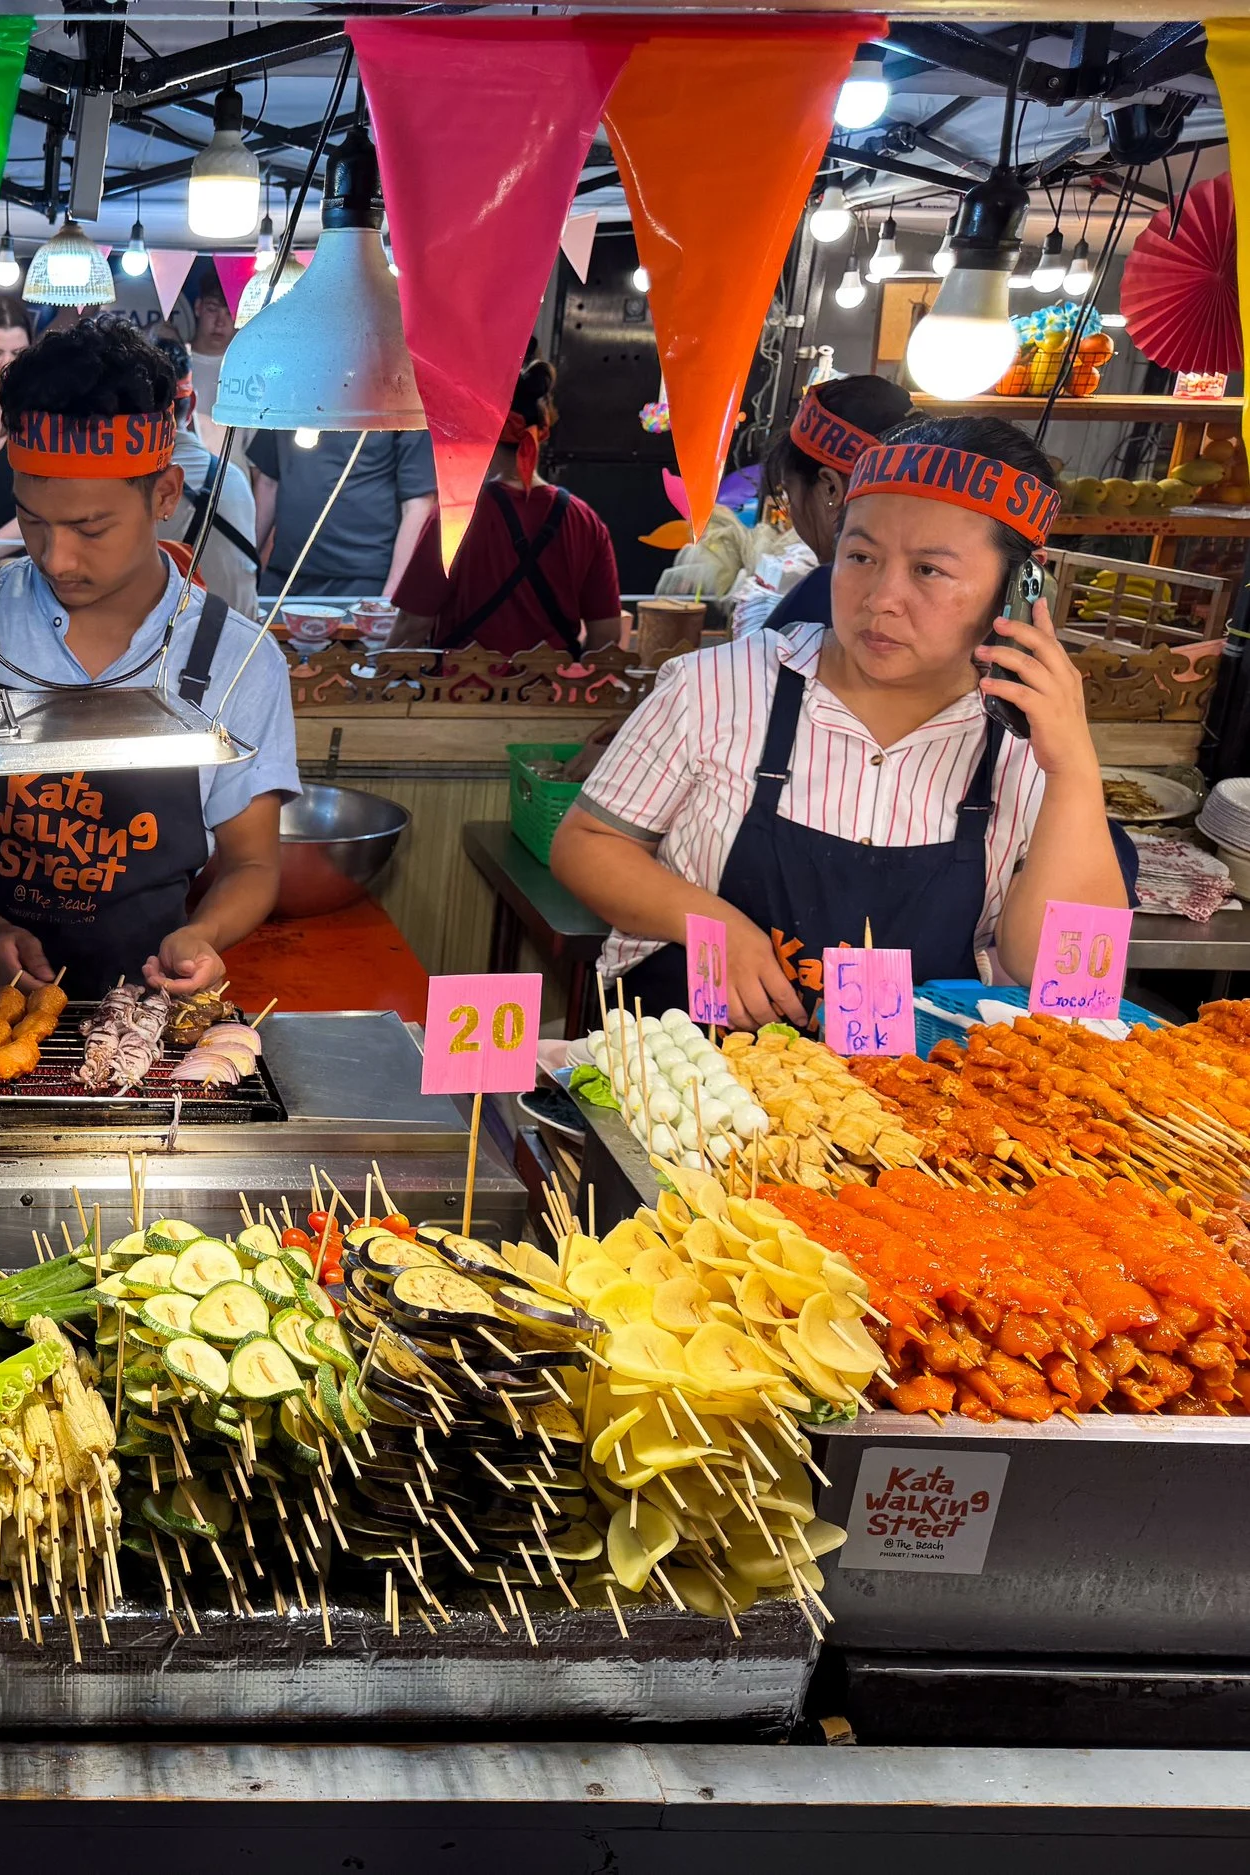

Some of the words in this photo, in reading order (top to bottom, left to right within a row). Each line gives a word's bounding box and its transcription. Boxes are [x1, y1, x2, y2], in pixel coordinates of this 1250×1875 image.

[6, 771, 104, 820] Kata
[697, 941, 722, 987] 40
[1055, 931, 1113, 978] 50
[838, 963, 902, 1019] 50
[448, 1002, 526, 1054] 20
[886, 1466, 955, 1495] Kata
[867, 1513, 965, 1538] Street
[884, 1538, 894, 1549] @
[895, 1539, 913, 1551] The
[916, 1539, 944, 1551] Beach
